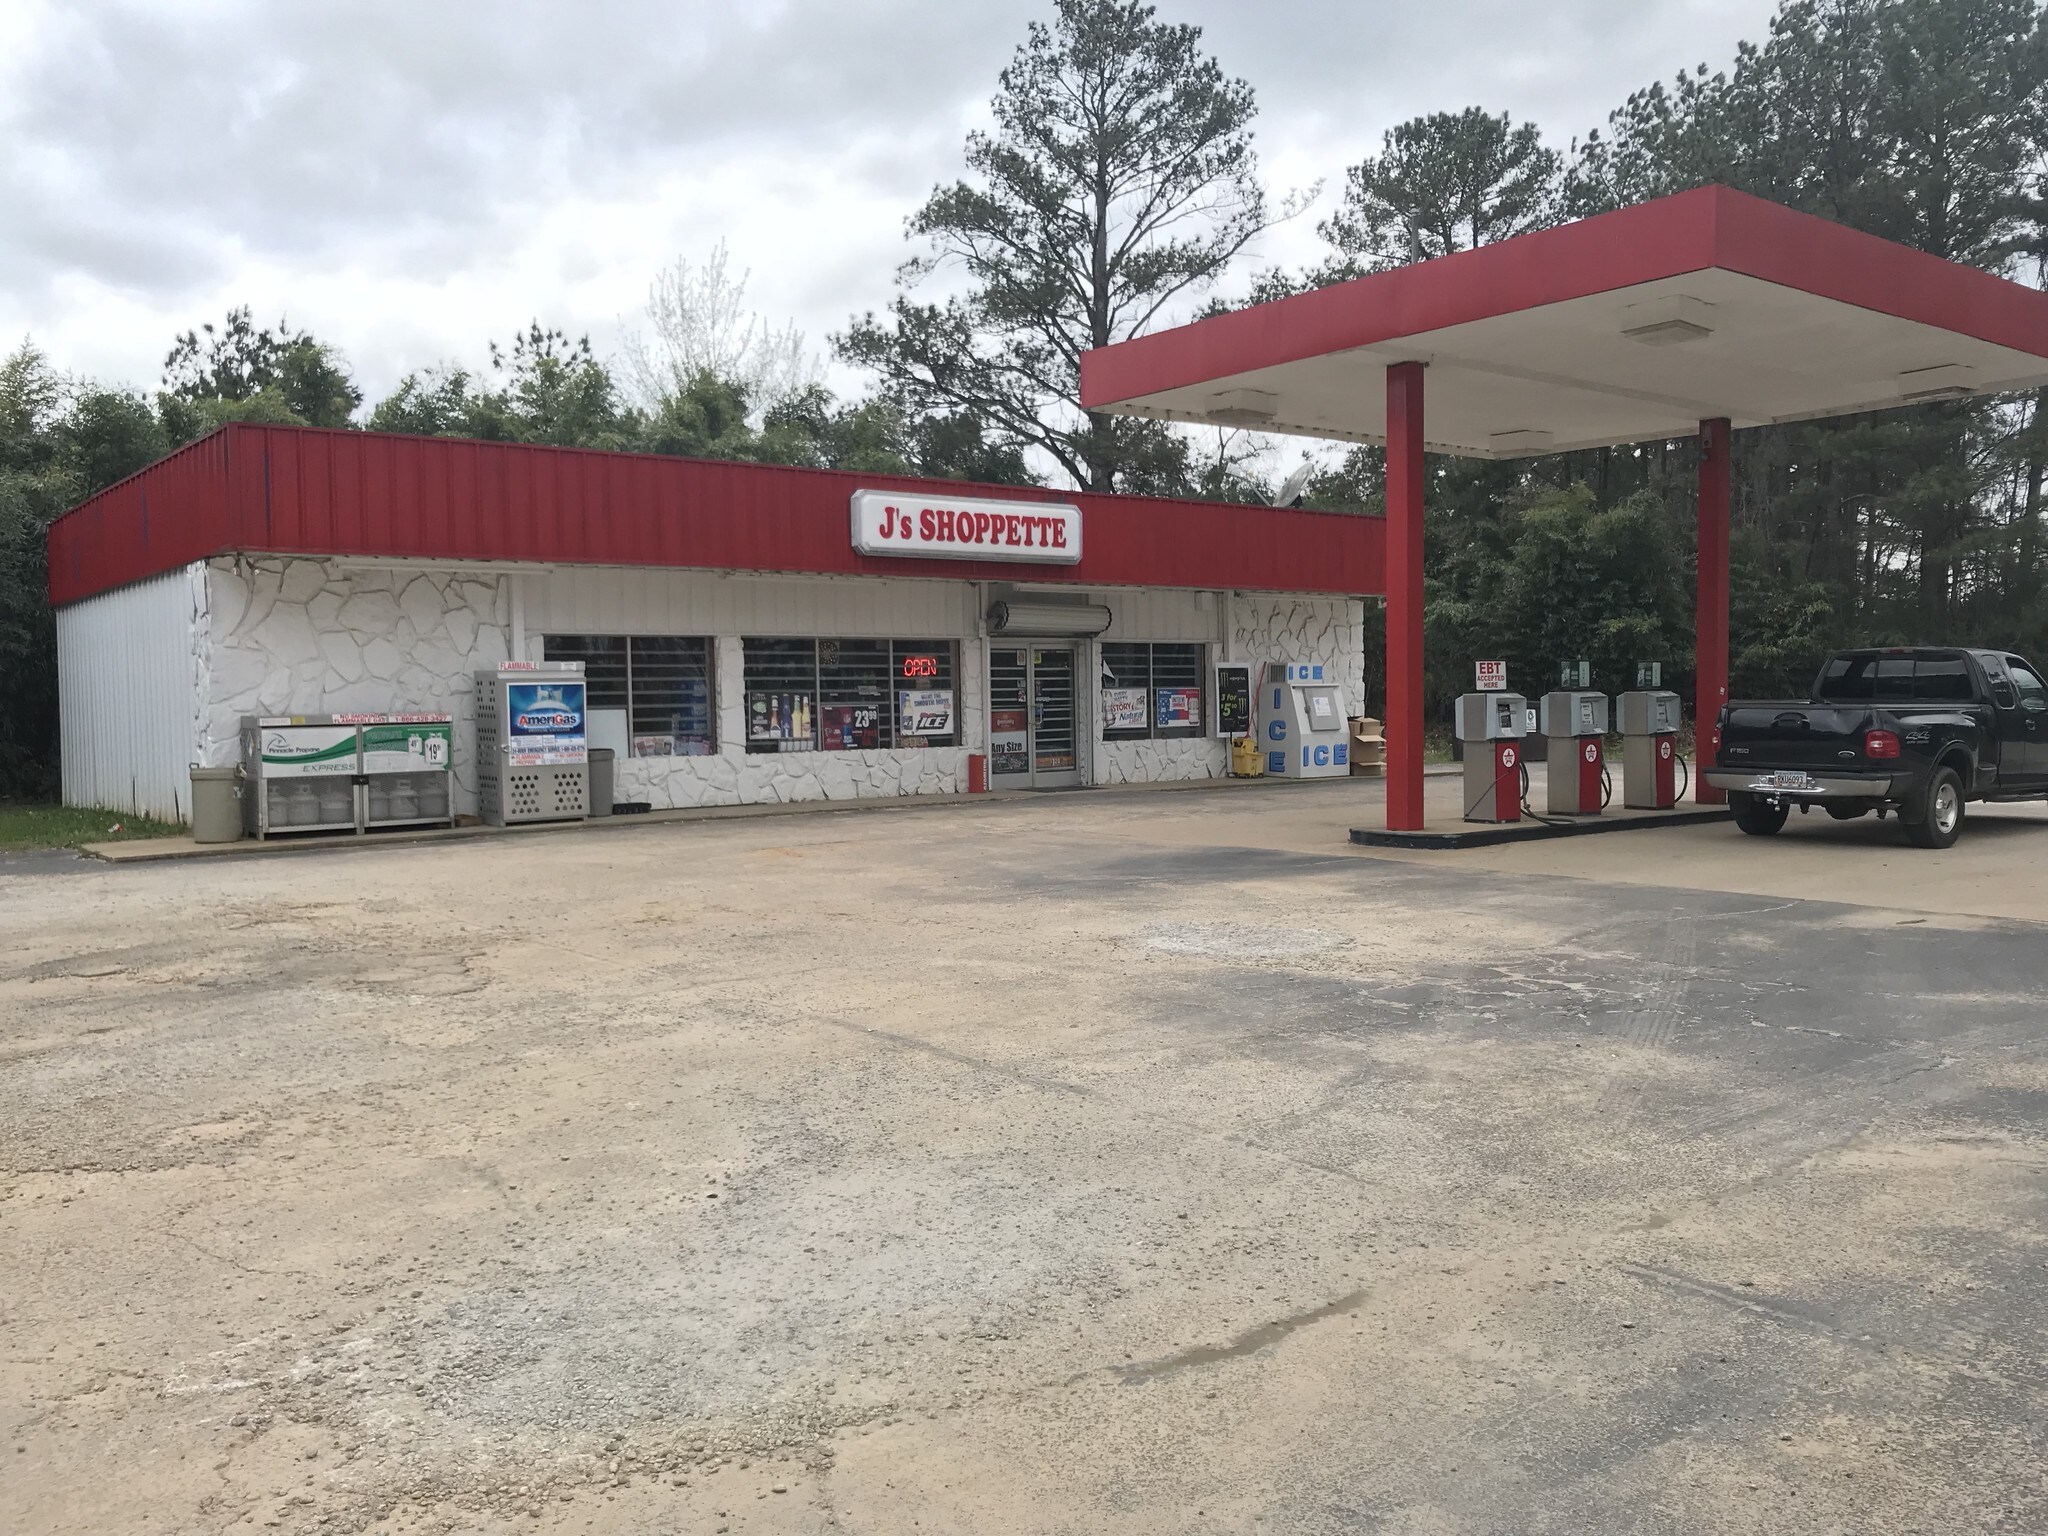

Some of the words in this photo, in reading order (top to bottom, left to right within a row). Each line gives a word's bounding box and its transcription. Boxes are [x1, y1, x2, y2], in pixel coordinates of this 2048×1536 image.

[879, 506, 912, 540] J's
[919, 509, 1067, 549] SHOPPETTE
[500, 661, 539, 671] FLAMMABLE
[903, 658, 937, 676] OPEN
[1479, 662, 1501, 675] EBT
[1288, 665, 1323, 680] ICE
[1483, 681, 1499, 689] HERE
[1227, 693, 1237, 701] for
[1112, 702, 1131, 712] STORY
[518, 714, 577, 727] AmeriGas
[1120, 710, 1144, 721] Natural
[919, 716, 946, 728] ICE
[1268, 688, 1287, 773] ICE
[992, 743, 1006, 753] Any
[1006, 741, 1023, 752] Size
[1303, 743, 1348, 767] ICE
[302, 763, 356, 773] EXPRESS
